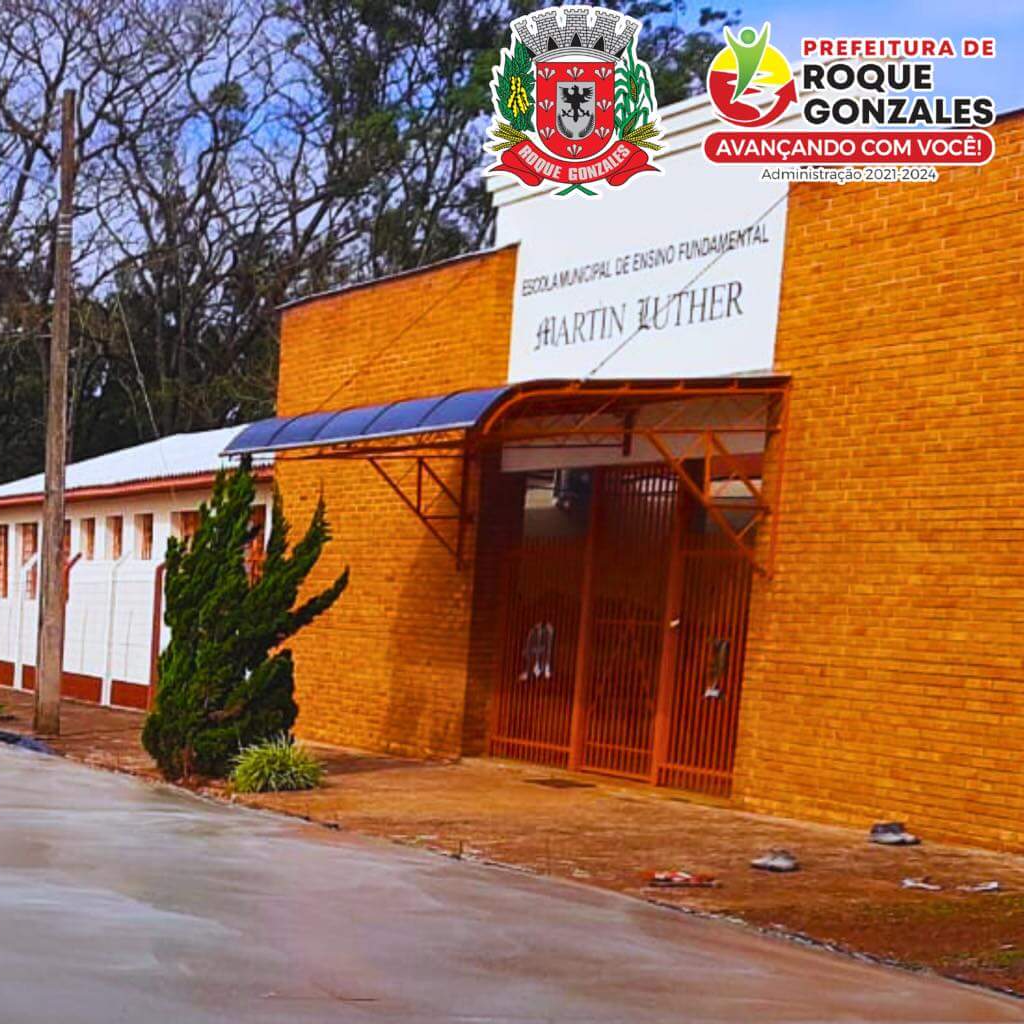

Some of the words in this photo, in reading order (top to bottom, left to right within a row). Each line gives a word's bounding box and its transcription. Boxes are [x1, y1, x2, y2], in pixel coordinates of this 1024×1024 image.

[522, 272, 560, 297] ESCOLA
[559, 261, 612, 289] MUNICIPAL
[615, 255, 630, 276] DE
[633, 245, 675, 271] ENSINO
[678, 223, 770, 261] FUNDAMENTAL
[534, 302, 627, 351] MARTIN
[638, 280, 744, 331] LUTHER
